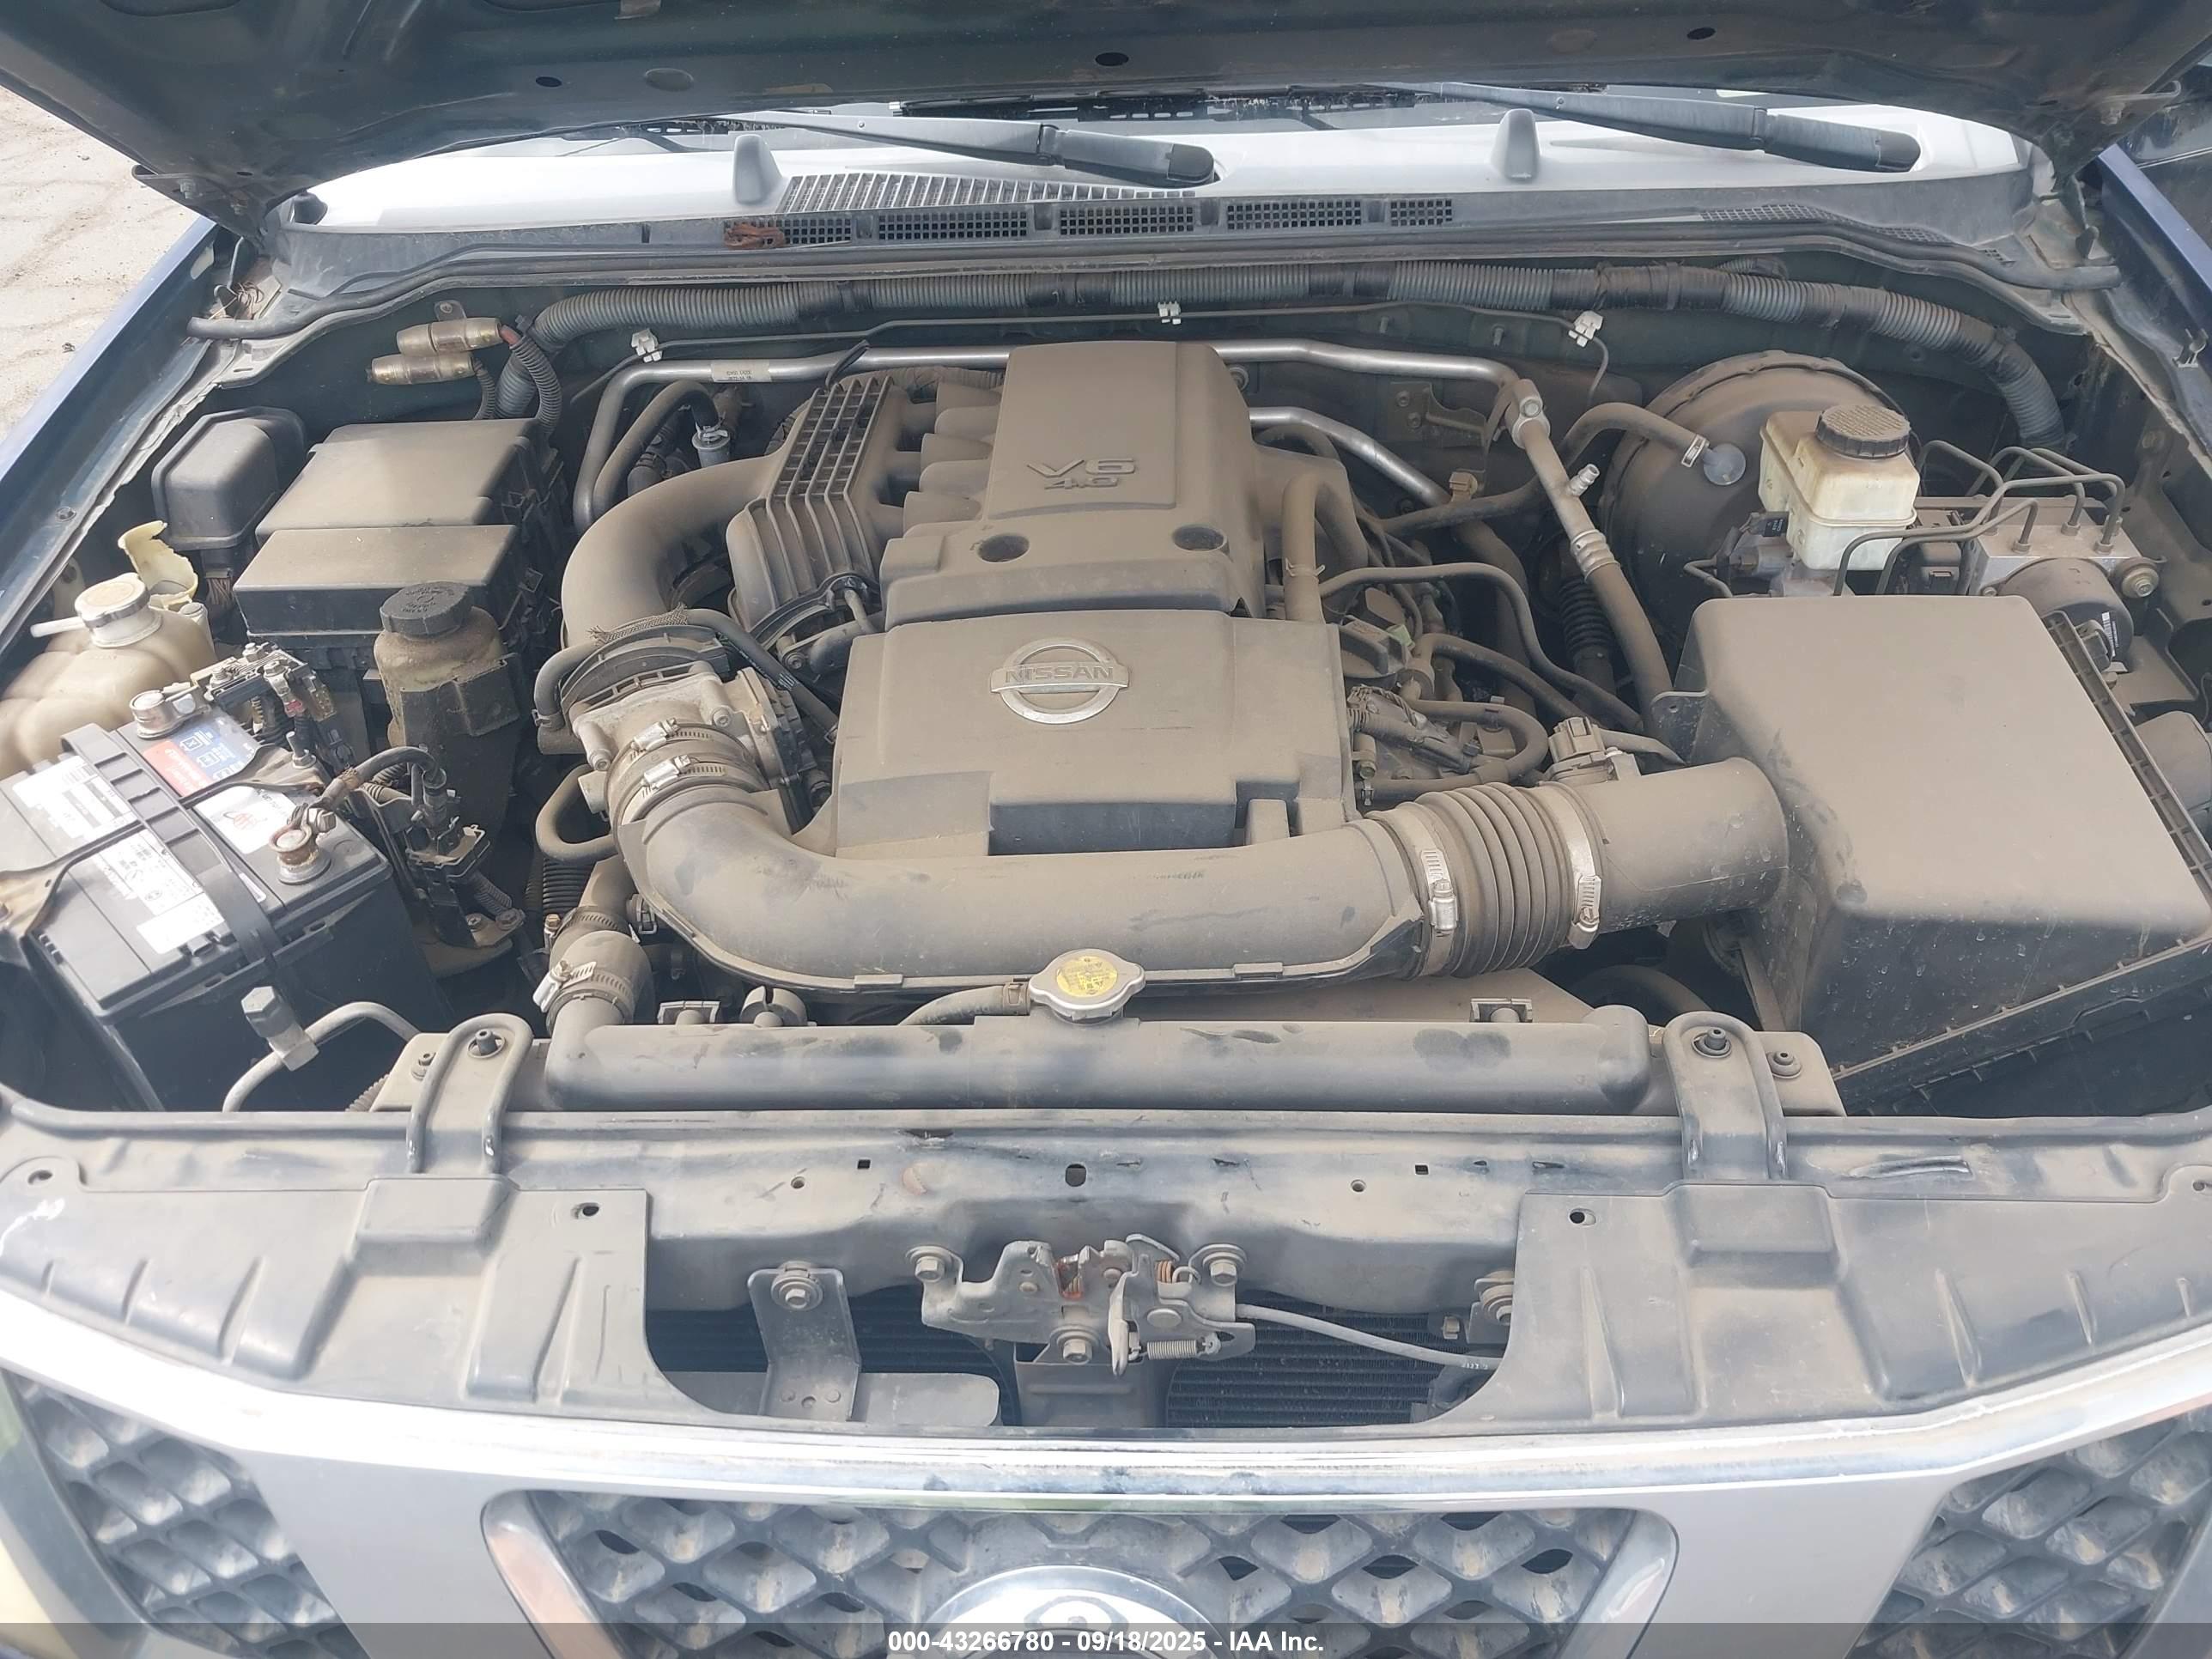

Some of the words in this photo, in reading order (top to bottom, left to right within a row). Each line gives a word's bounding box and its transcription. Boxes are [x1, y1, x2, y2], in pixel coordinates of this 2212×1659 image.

[1026, 457, 1135, 478] V6
[1043, 477, 1119, 490] 4.0
[1005, 665, 1114, 684] NISSAN
